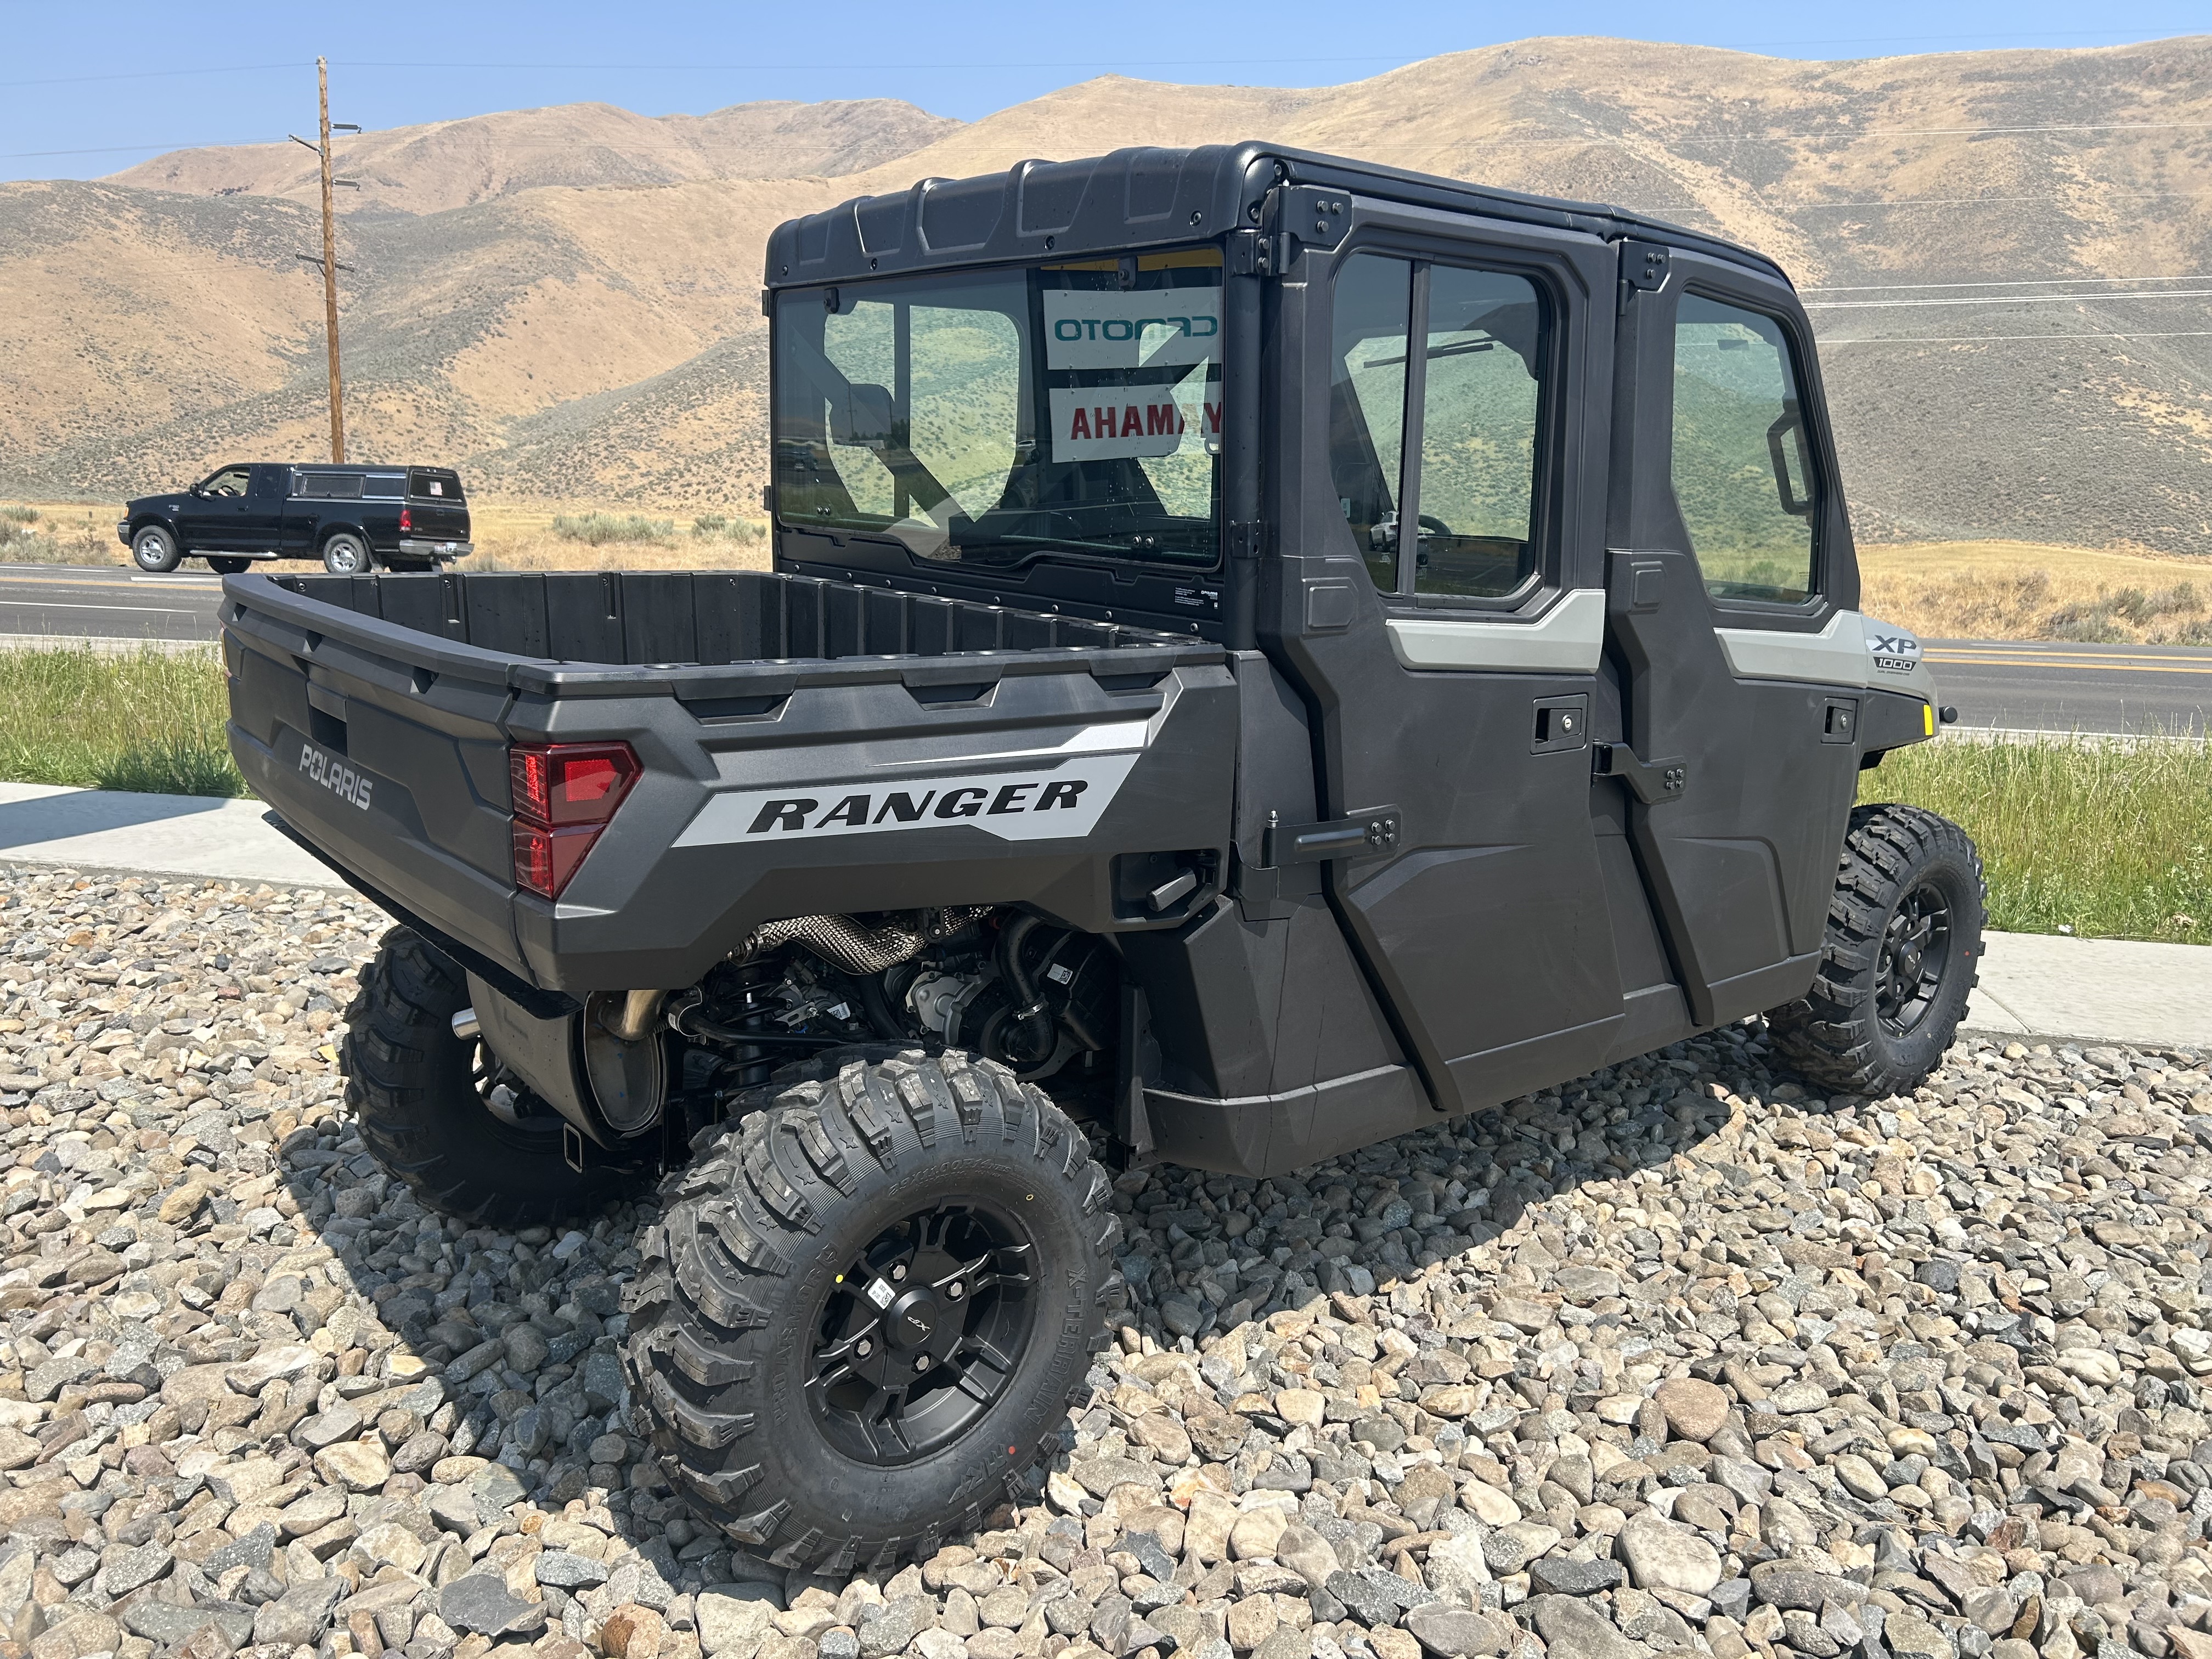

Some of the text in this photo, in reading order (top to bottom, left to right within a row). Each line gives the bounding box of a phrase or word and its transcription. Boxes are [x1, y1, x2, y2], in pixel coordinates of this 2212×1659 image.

[1872, 635, 1917, 654] XP
[1878, 658, 1912, 670] 1000
[298, 743, 373, 810] POLARIS
[746, 780, 1088, 833] RANGER
[776, 1267, 823, 1365] ARMOR
[1024, 1263, 1088, 1424] X-TERRAIN
